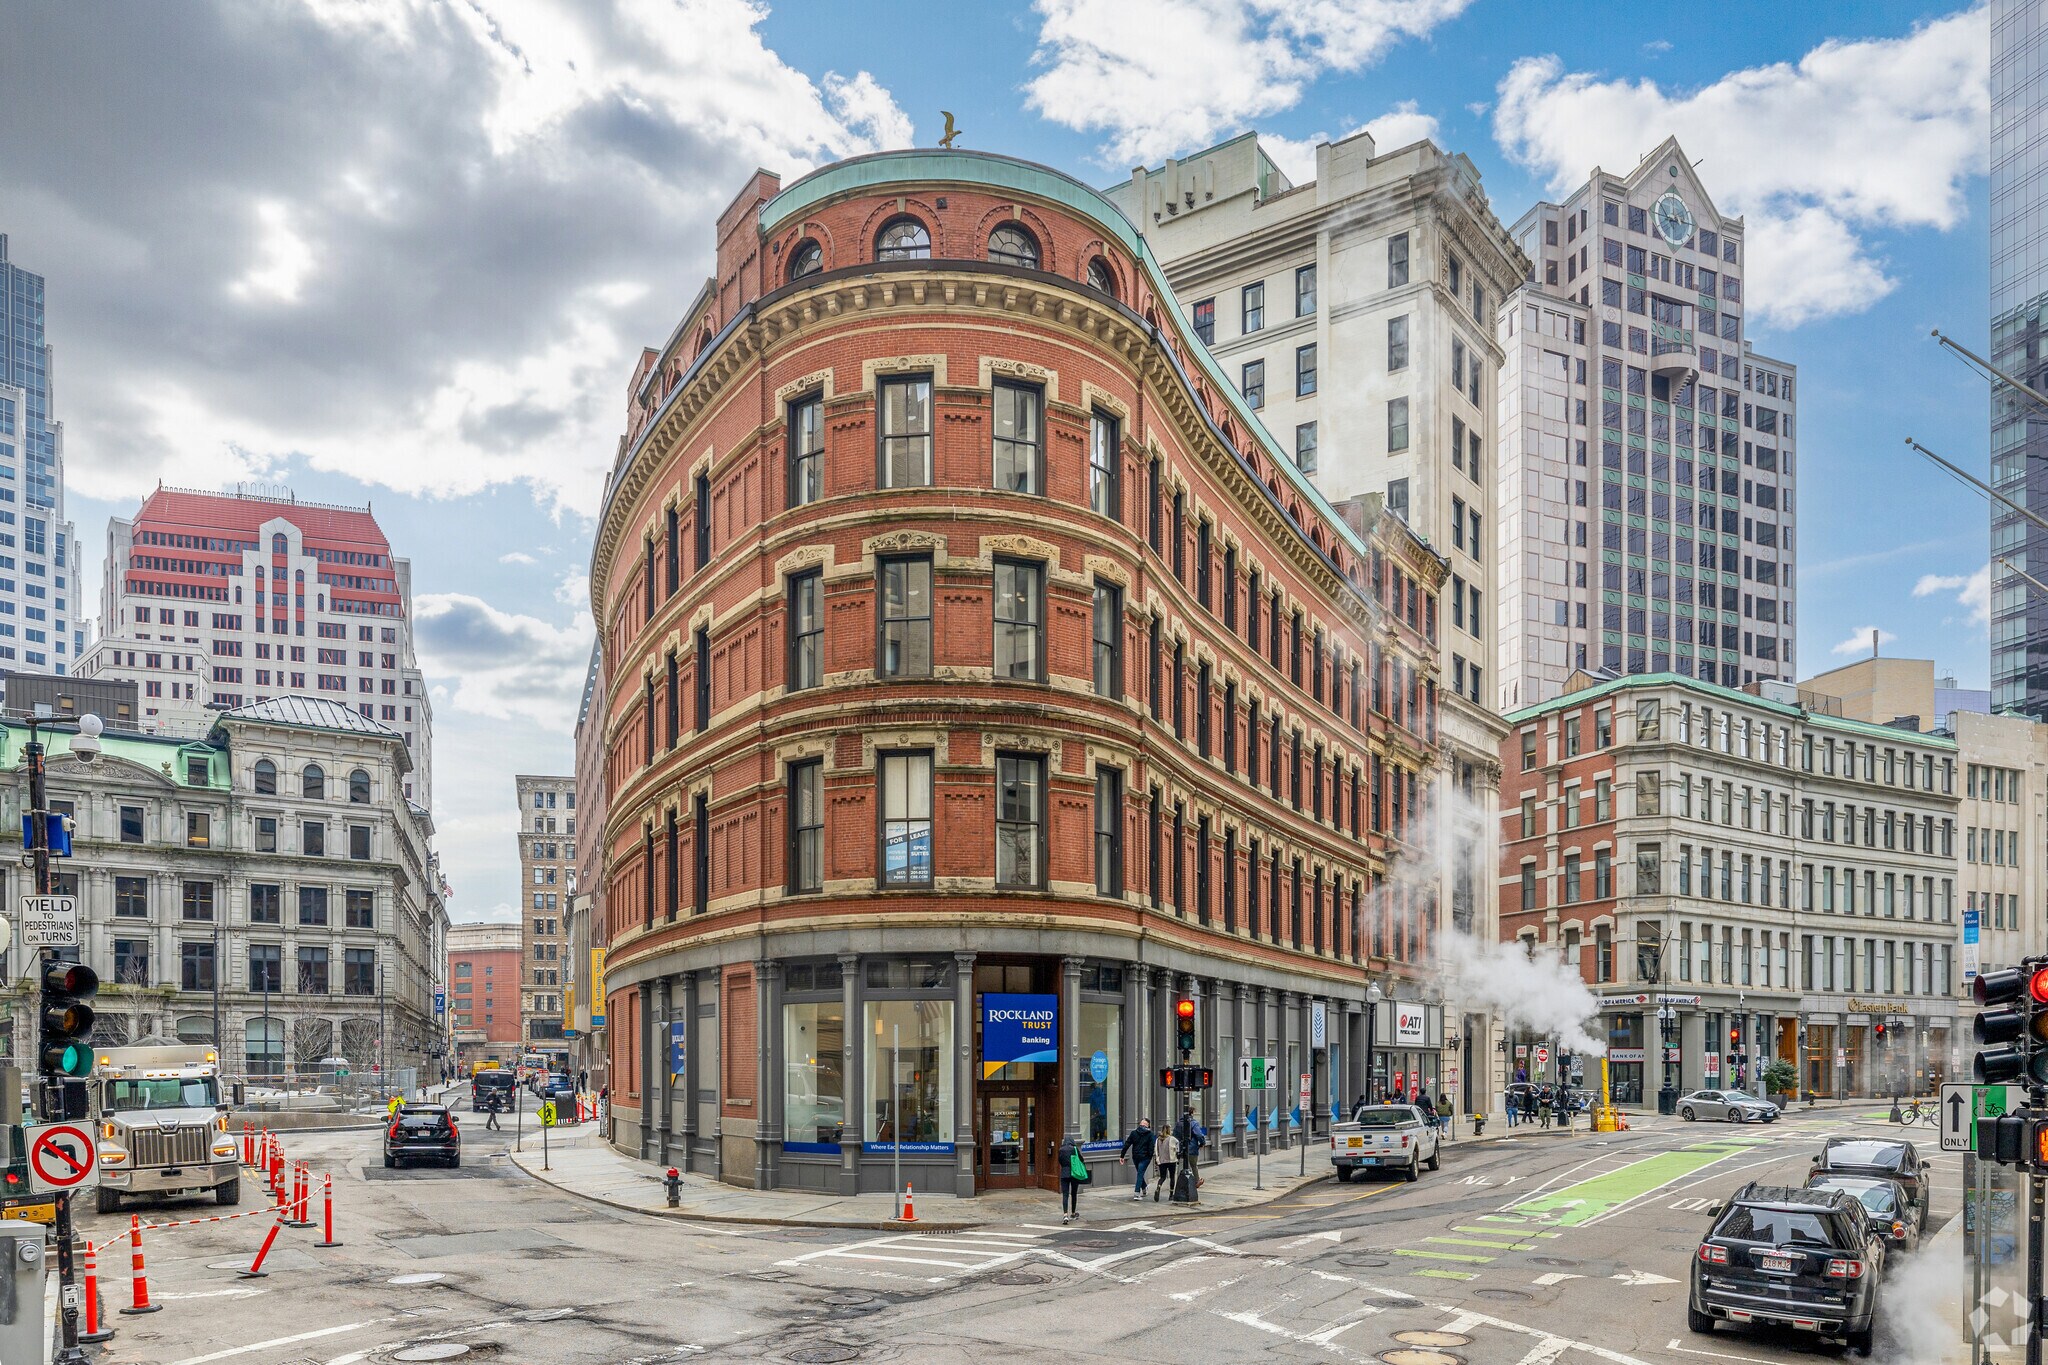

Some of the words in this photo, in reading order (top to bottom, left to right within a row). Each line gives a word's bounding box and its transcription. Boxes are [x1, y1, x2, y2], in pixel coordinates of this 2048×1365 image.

[890, 836, 903, 844] FOR
[910, 831, 929, 840] LEASE
[25, 899, 72, 911] YIELD
[25, 921, 74, 930] PEDESTRIANS
[40, 932, 72, 941] TURNS
[437, 997, 442, 1005] 7
[1858, 1002, 1886, 1012] Eastern
[1887, 1002, 1908, 1013] Bank
[988, 1009, 1053, 1022] ROCKLAND
[1407, 1016, 1421, 1029] ATI
[1022, 1036, 1050, 1045] Banking
[1944, 1138, 1968, 1146] ONLY
[1446, 1176, 1526, 1186] NLY
[1667, 1198, 1721, 1210] ON
